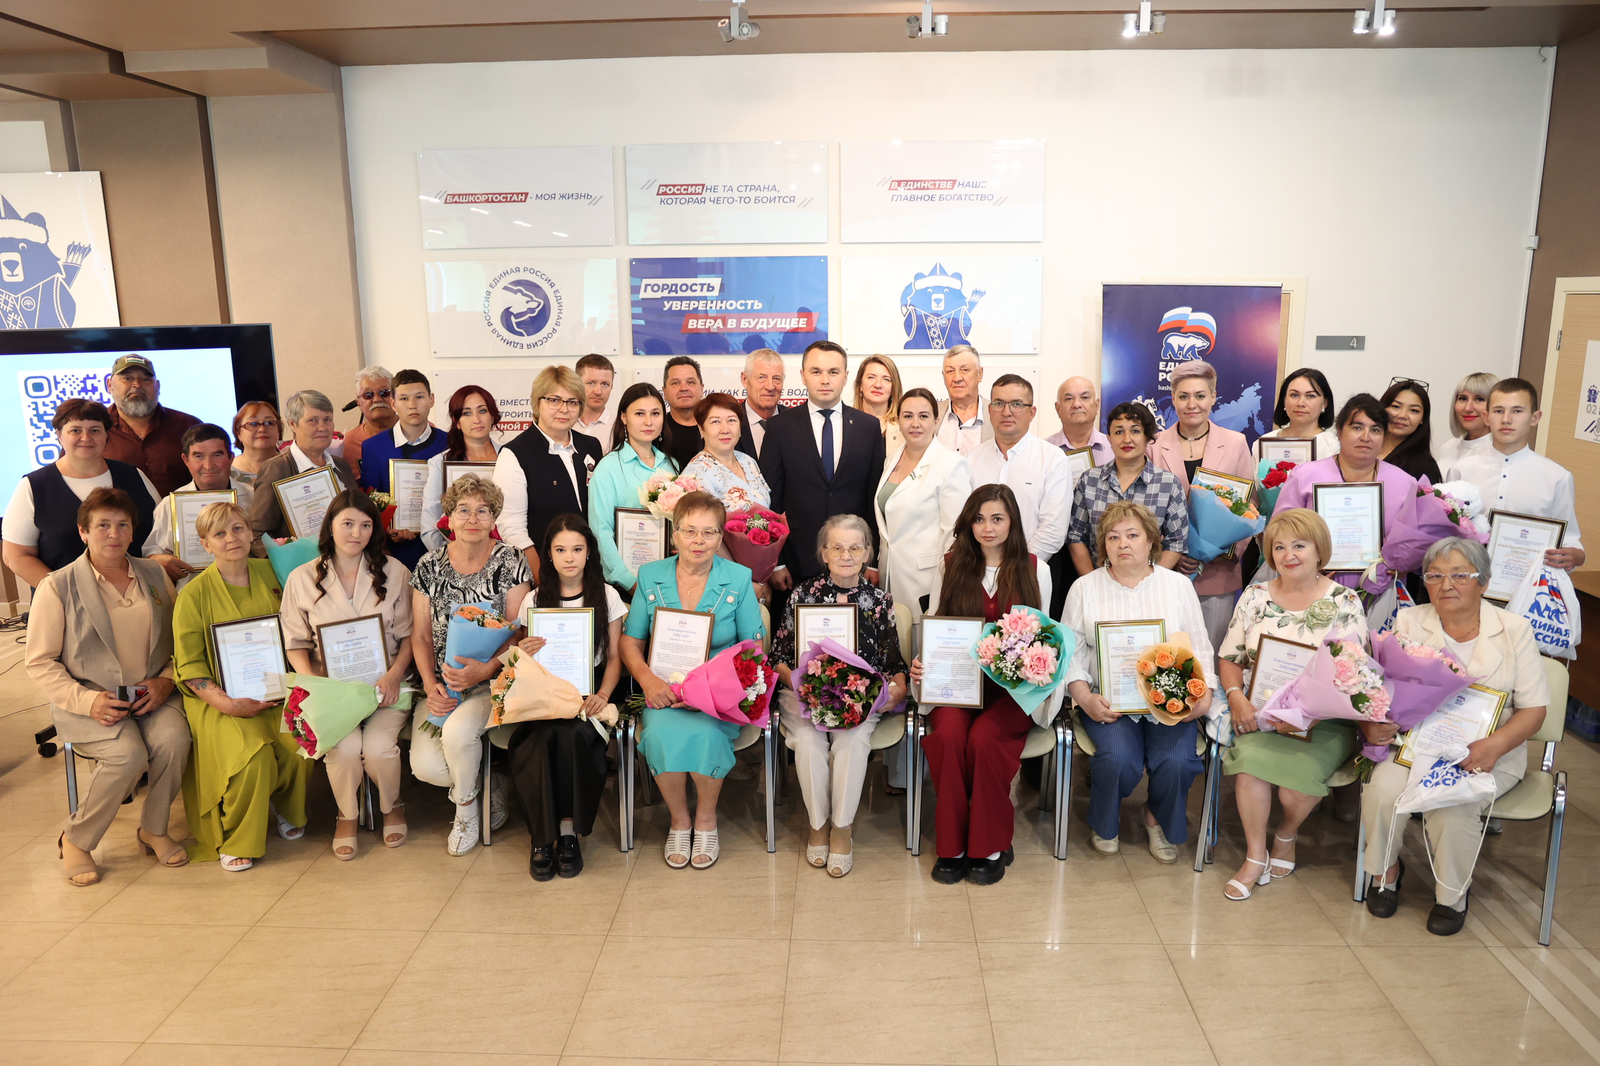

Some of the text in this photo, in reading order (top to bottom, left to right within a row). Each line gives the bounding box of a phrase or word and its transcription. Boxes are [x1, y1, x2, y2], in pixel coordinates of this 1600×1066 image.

[658, 184, 781, 195] РОССИЯ НЕ ТА СТРАНА,
[891, 181, 899, 189] В
[900, 180, 953, 190] ЕДИНСТВЕ
[446, 193, 526, 203] БАШКОРТОСТАН
[535, 193, 556, 201] МОЯ
[558, 192, 593, 201] ЖИЗНЬ
[659, 195, 796, 205] КОТОРАЯ ЧЕГО-ТО БОИТСЯ
[891, 193, 995, 202] ГЛАВНОЕ БОГАТСТВО
[643, 282, 715, 294] ГОРДОСТЬ
[483, 266, 563, 350] ЕДИНАЯ РОССИЯ ЕДИНАЯ РОССИЯ ЕДИНАЯ РОССИЯ
[662, 299, 763, 311] УВЕРЕННОСТЬ
[687, 317, 808, 330] ВЕРА В БУДУЩЕЕ
[1350, 336, 1358, 349] 4
[1586, 403, 1597, 415] 02
[1523, 614, 1571, 638] ДИНАЯ
